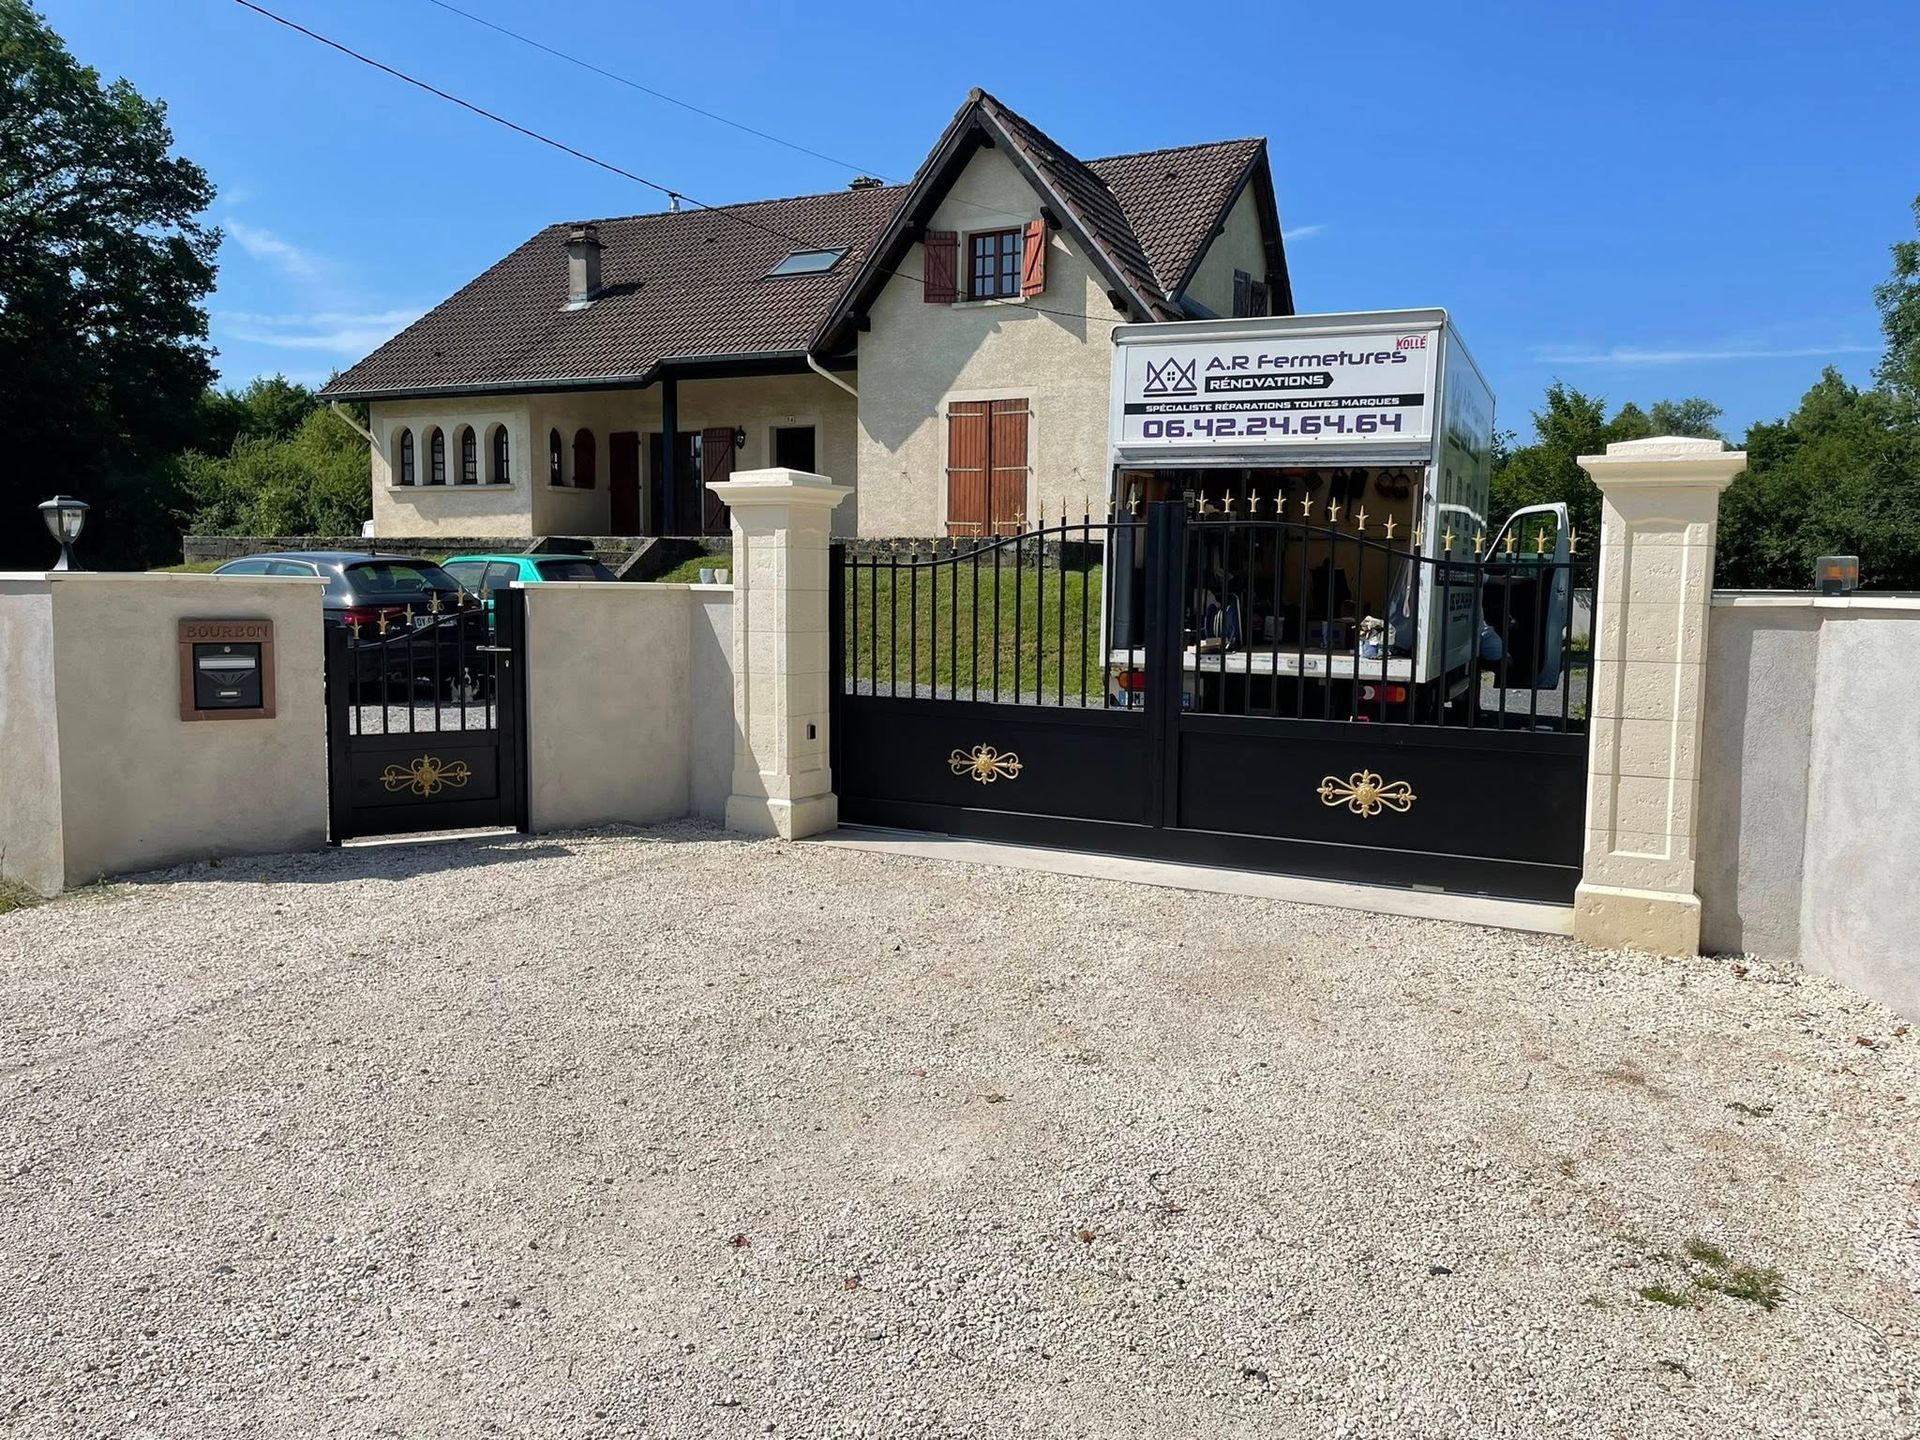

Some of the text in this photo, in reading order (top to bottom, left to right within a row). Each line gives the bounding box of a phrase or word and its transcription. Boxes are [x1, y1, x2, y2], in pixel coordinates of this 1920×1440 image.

[1205, 350, 1407, 372] A.R Fermetures
[1209, 374, 1324, 390] RÉNOVATIONS
[1145, 397, 1400, 413] SPÉCIALISTE RÉPARATIONS TOUTES MARQUES
[1143, 413, 1402, 438] 06.42.24.64.64
[187, 624, 268, 638] BOURBON
